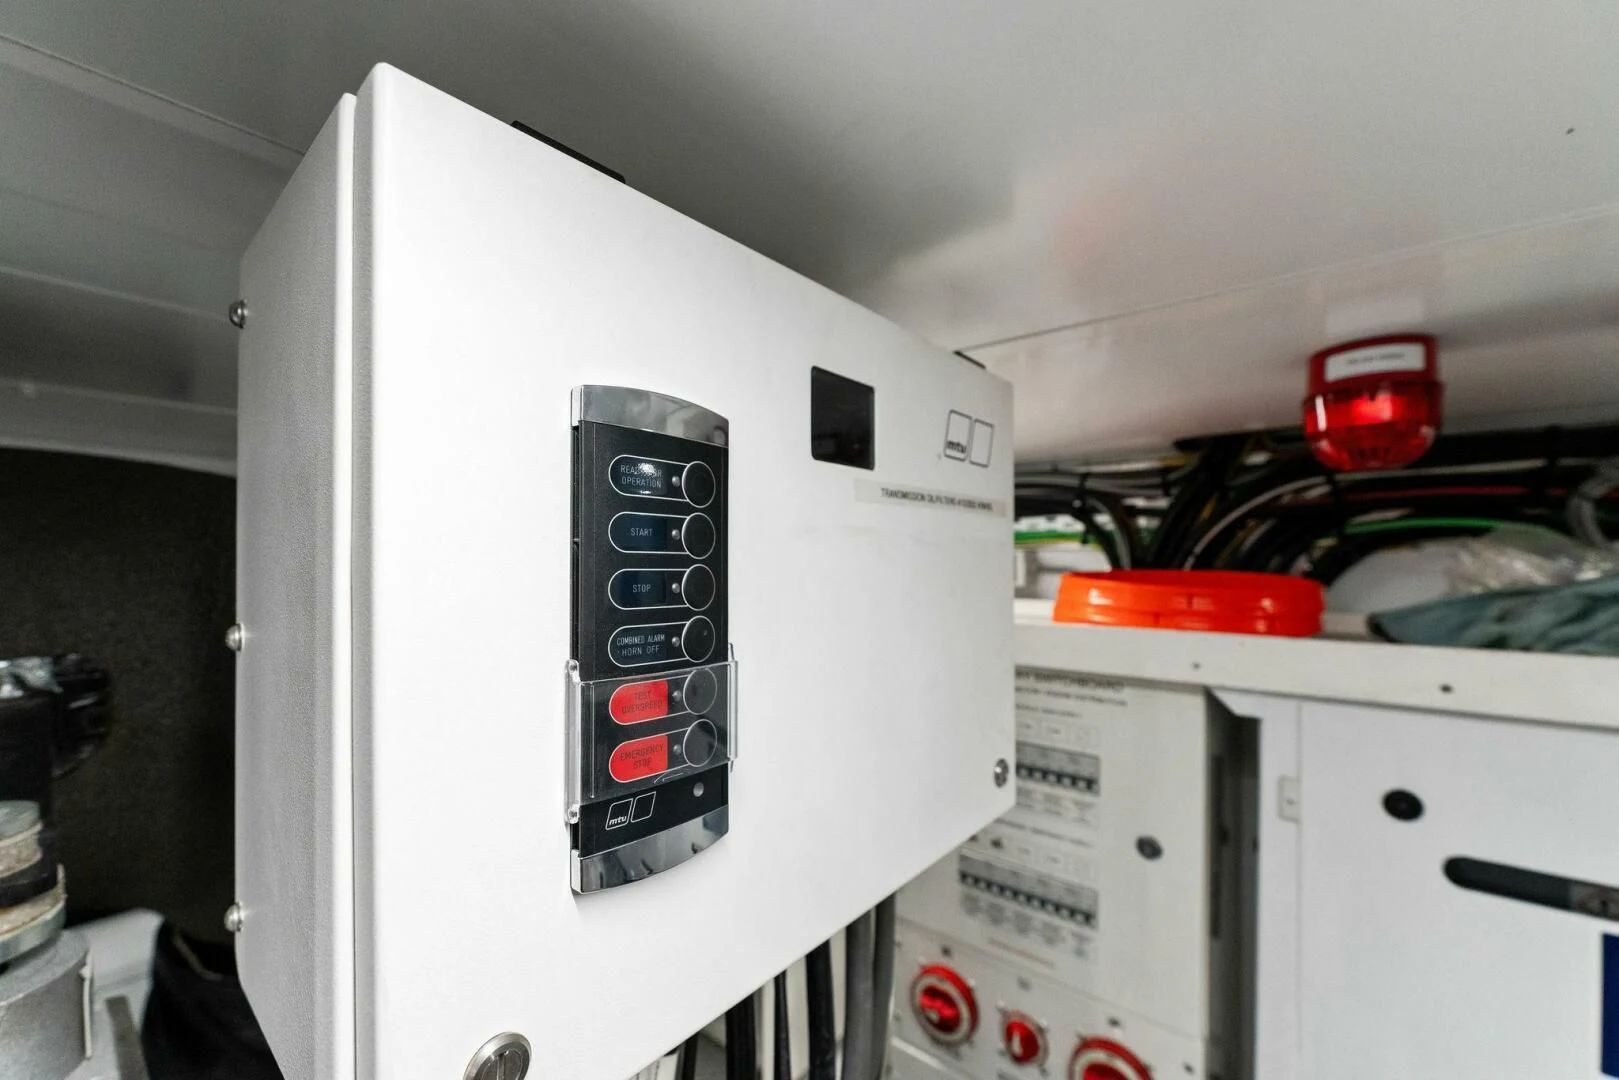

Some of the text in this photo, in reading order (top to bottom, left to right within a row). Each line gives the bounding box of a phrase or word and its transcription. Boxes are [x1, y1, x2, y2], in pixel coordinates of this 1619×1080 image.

[946, 440, 967, 454] mtu
[620, 464, 644, 475] READ
[621, 476, 662, 488] OPERATION
[630, 527, 653, 537] START
[632, 584, 651, 593] STOP
[616, 633, 665, 646] COMBINED ALARM
[621, 644, 660, 657] HORN OFF
[634, 690, 651, 700] TEST
[621, 700, 663, 714] OVERSPEED
[620, 743, 664, 760] EMERGENCY
[633, 757, 652, 769] STOP
[609, 815, 627, 826] mtu
